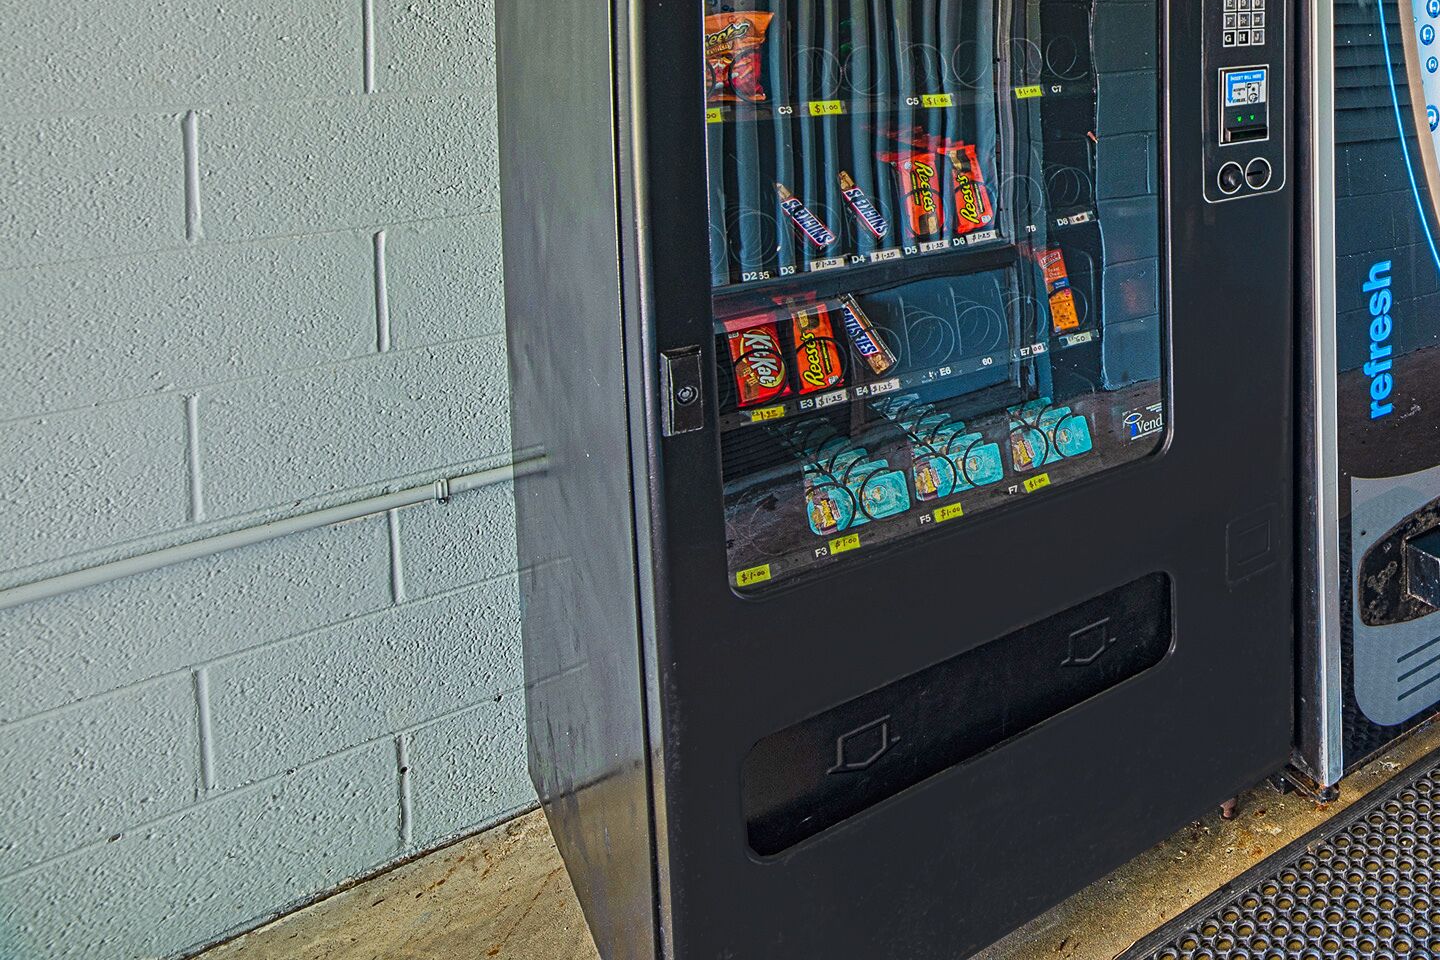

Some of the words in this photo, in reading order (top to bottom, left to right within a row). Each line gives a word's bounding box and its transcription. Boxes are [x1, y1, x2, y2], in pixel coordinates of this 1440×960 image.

[1051, 85, 1063, 93] C7
[906, 97, 919, 106] C5
[778, 105, 793, 115] C3
[814, 104, 839, 114] $1.00
[847, 189, 888, 235] SNICKES
[783, 199, 833, 245] SNICKES
[1057, 218, 1069, 226] D8
[953, 237, 966, 247] D6
[904, 246, 918, 255] D5
[852, 255, 865, 264] D4
[779, 265, 795, 276] D3
[742, 271, 757, 282] D2
[1363, 260, 1393, 419] refresh
[1020, 347, 1030, 356] E7
[803, 332, 826, 386] Reese's
[940, 366, 951, 376] E6
[856, 386, 868, 395] E4
[801, 400, 814, 409] E3
[818, 394, 843, 407] $1.25
[1028, 477, 1046, 489] $1.00
[1008, 485, 1018, 495] F7
[941, 506, 960, 519] $1.00
[919, 514, 931, 524] F5
[835, 537, 857, 549] $1.00
[815, 547, 828, 557] F3
[741, 571, 765, 583] $1.00
